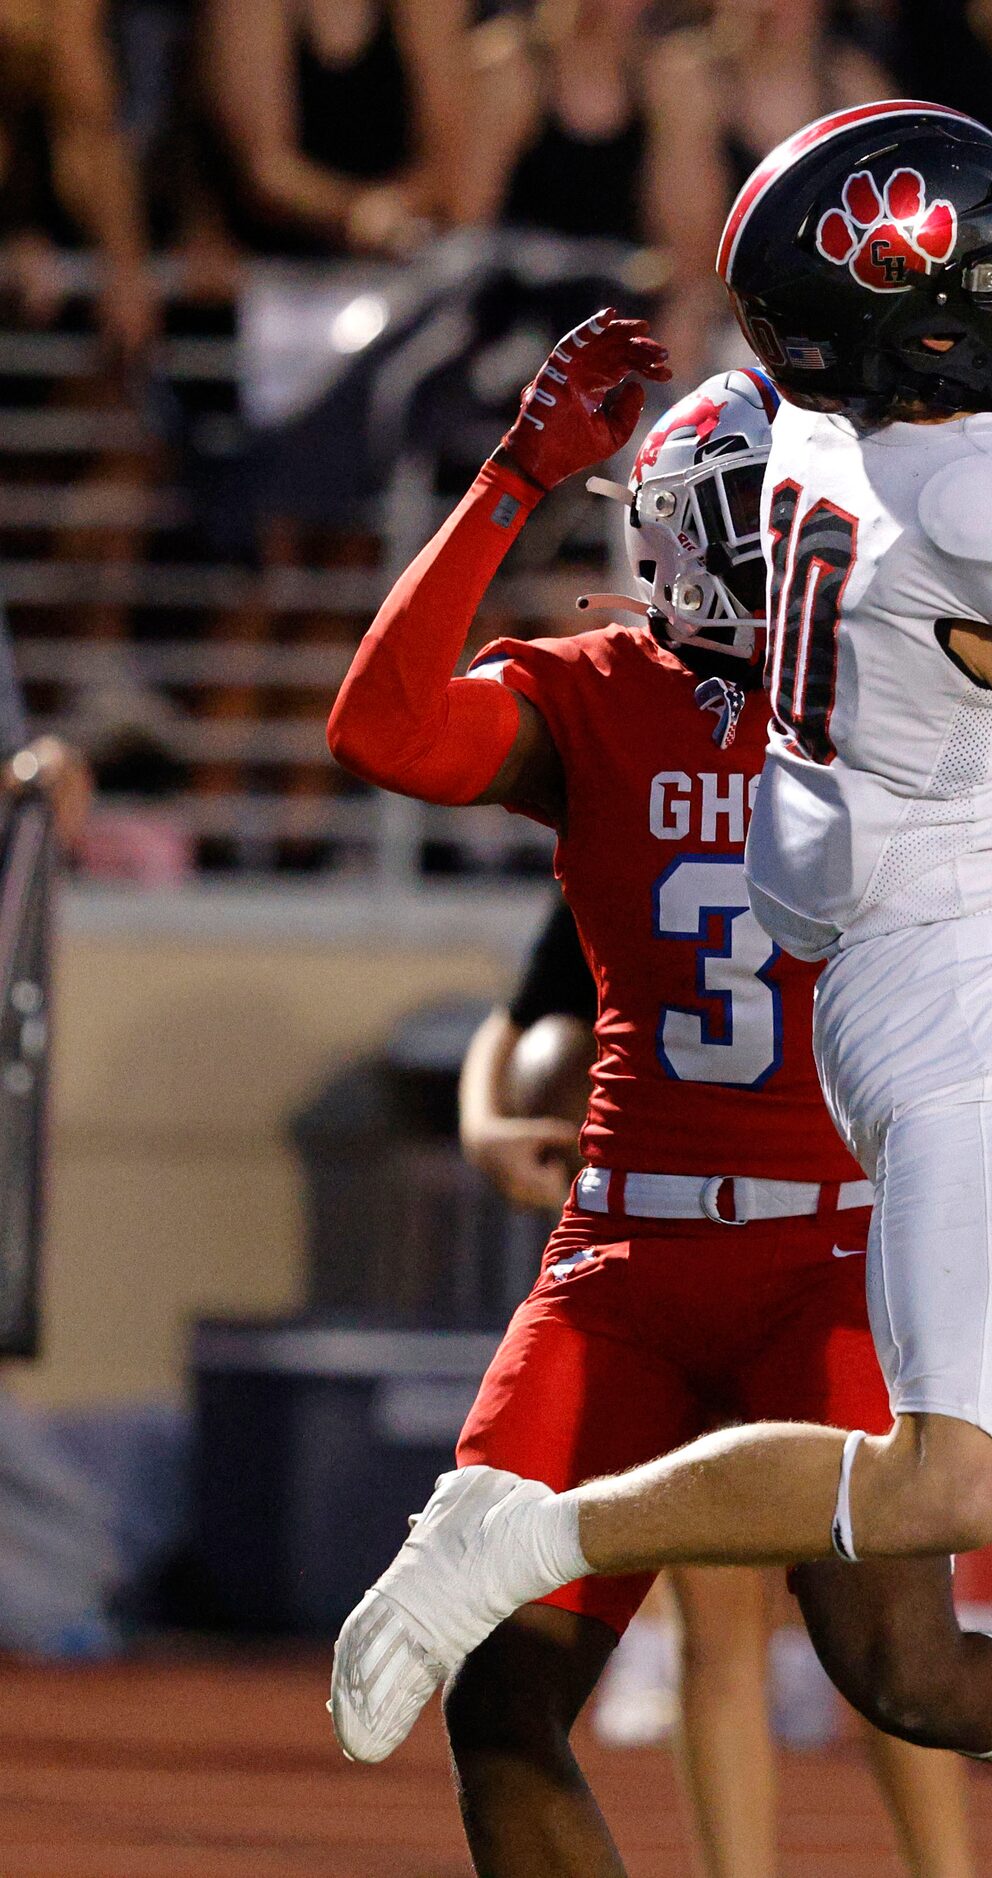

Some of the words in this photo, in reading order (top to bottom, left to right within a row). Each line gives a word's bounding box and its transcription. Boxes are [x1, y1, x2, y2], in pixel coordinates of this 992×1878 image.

[766, 477, 860, 766] 10
[649, 771, 764, 842] GH
[652, 853, 784, 1092] 3
